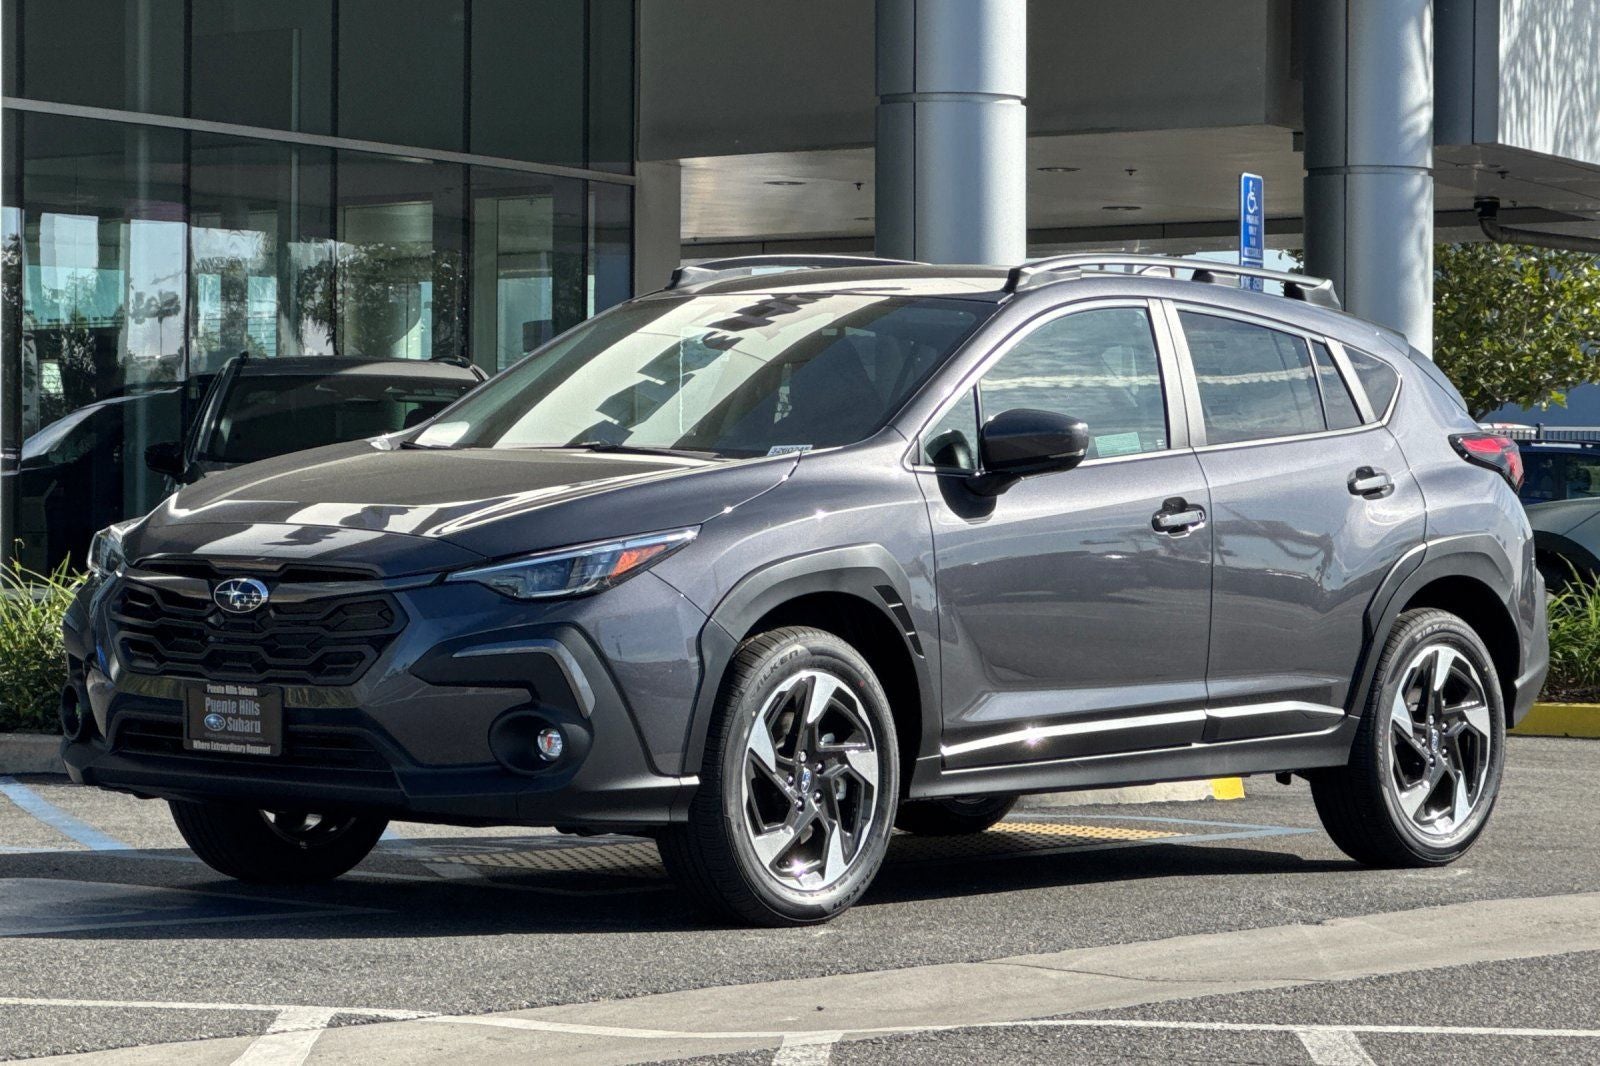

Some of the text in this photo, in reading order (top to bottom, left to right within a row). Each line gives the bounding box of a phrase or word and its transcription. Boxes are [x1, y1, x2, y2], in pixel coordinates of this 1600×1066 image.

[238, 686, 257, 696] Subaru
[205, 697, 260, 715] Puente Hills
[227, 716, 261, 733] Subaru
[193, 740, 210, 750] Where
[210, 741, 246, 754] Extraordinary
